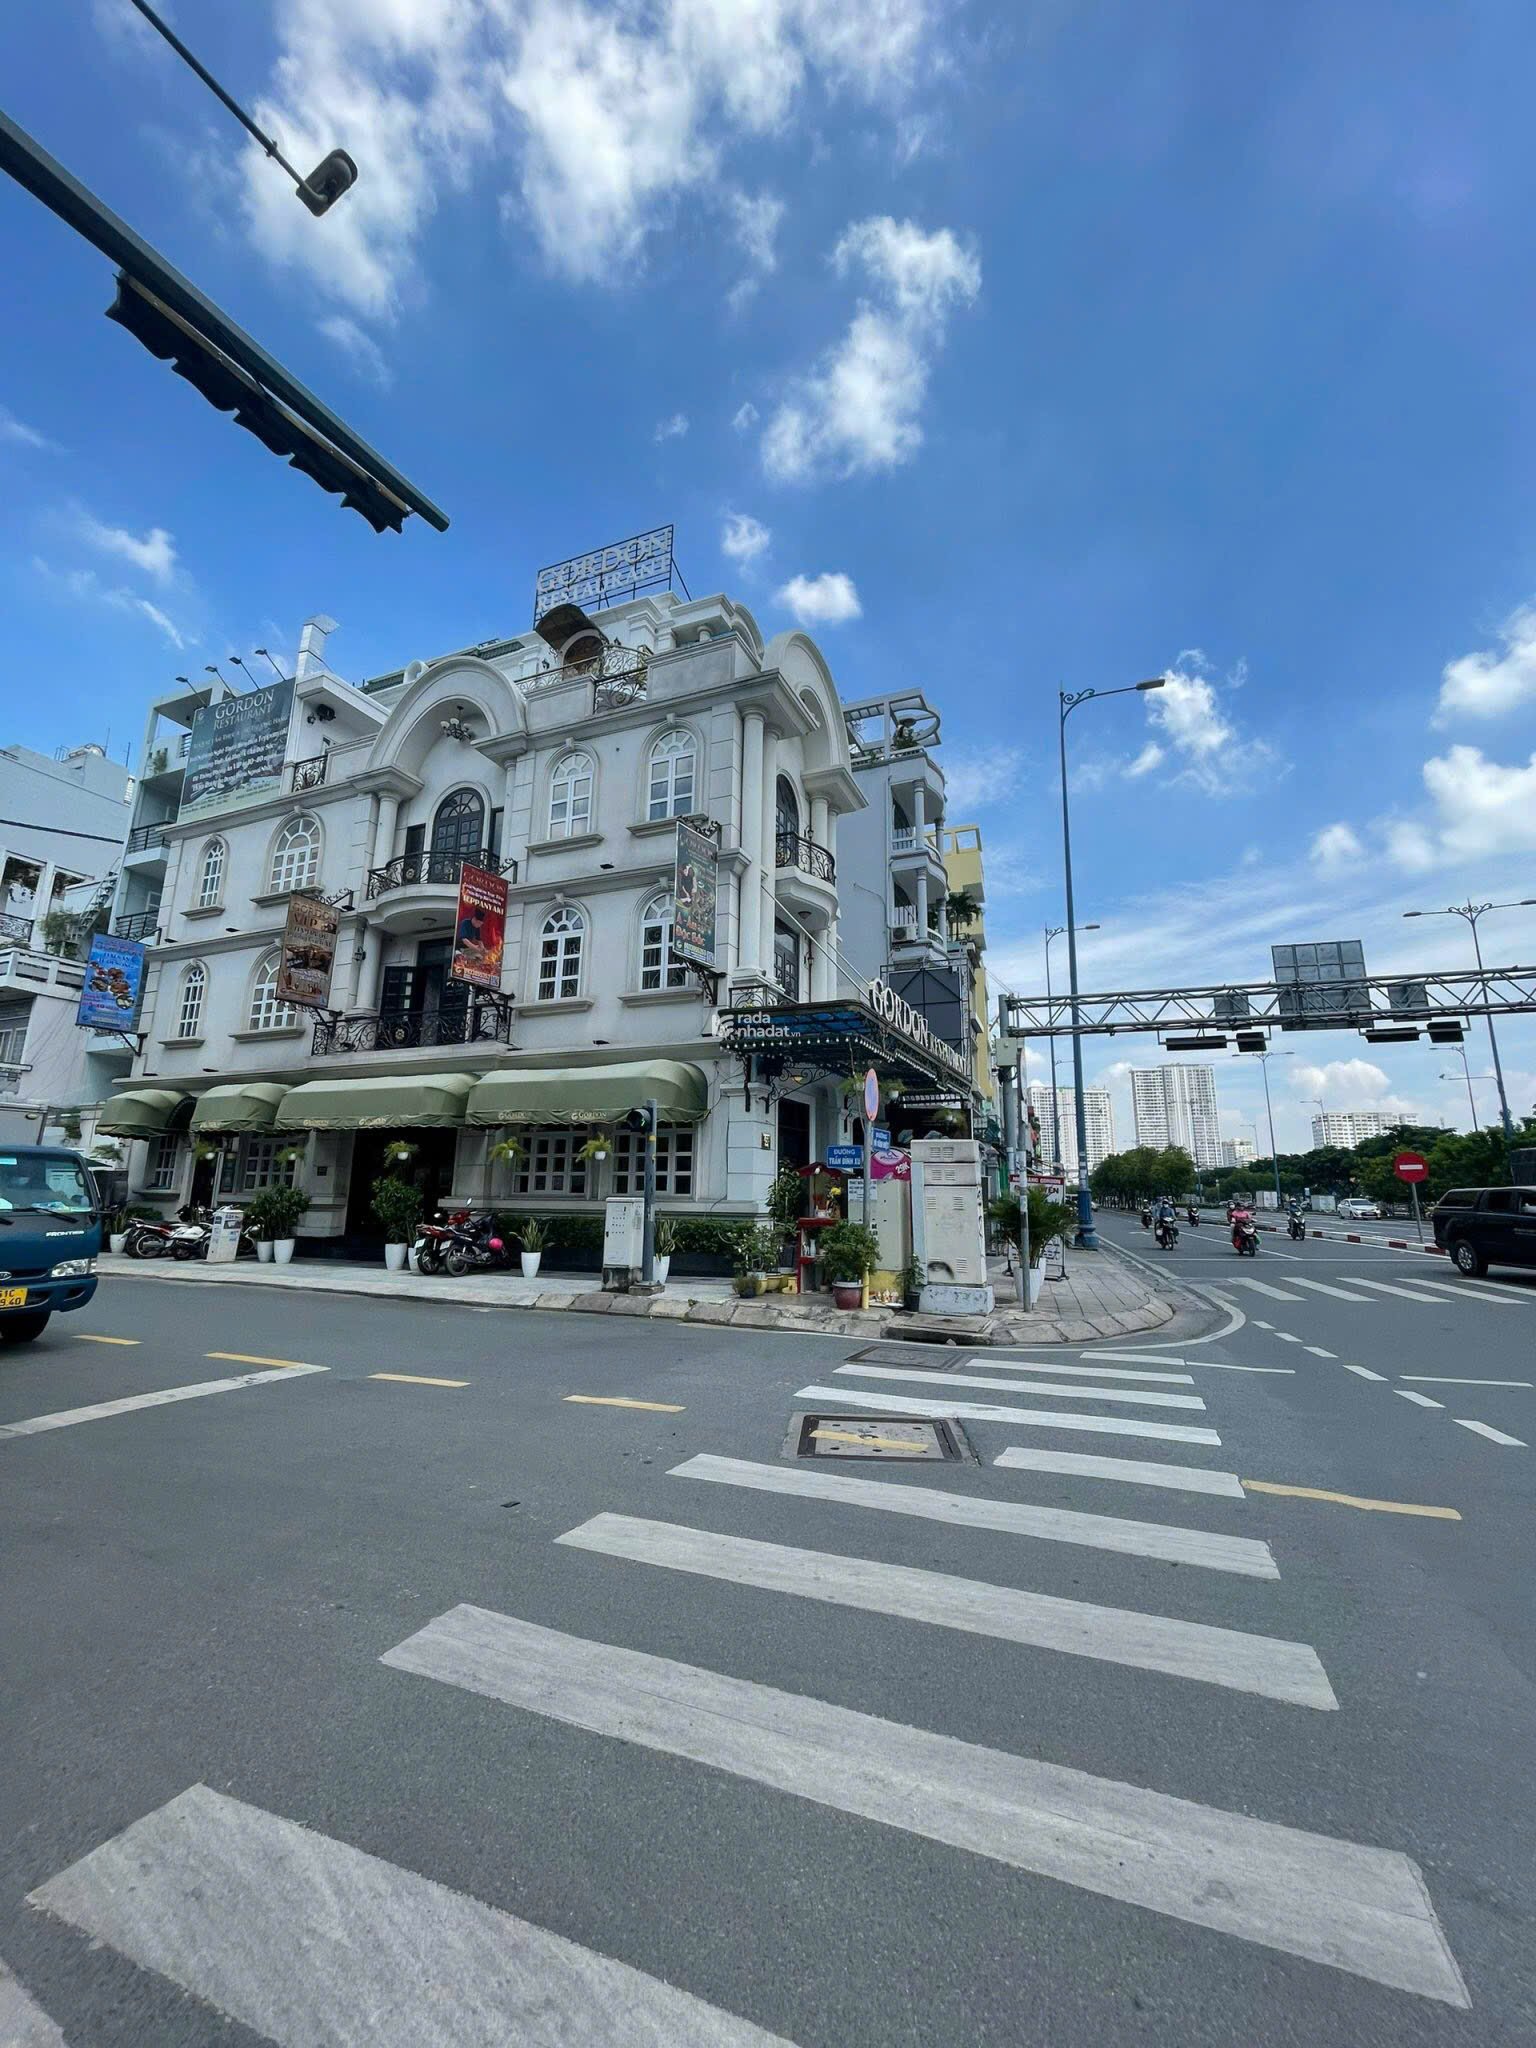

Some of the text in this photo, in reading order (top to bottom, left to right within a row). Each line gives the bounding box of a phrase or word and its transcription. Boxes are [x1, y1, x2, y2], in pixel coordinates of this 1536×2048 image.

[537, 527, 672, 594] GORDON
[536, 556, 670, 612] RESTAURANT
[214, 703, 272, 730] RESTAURANT
[215, 689, 275, 719] GORDON
[294, 913, 318, 927] VIP
[869, 978, 928, 1048] GORDON
